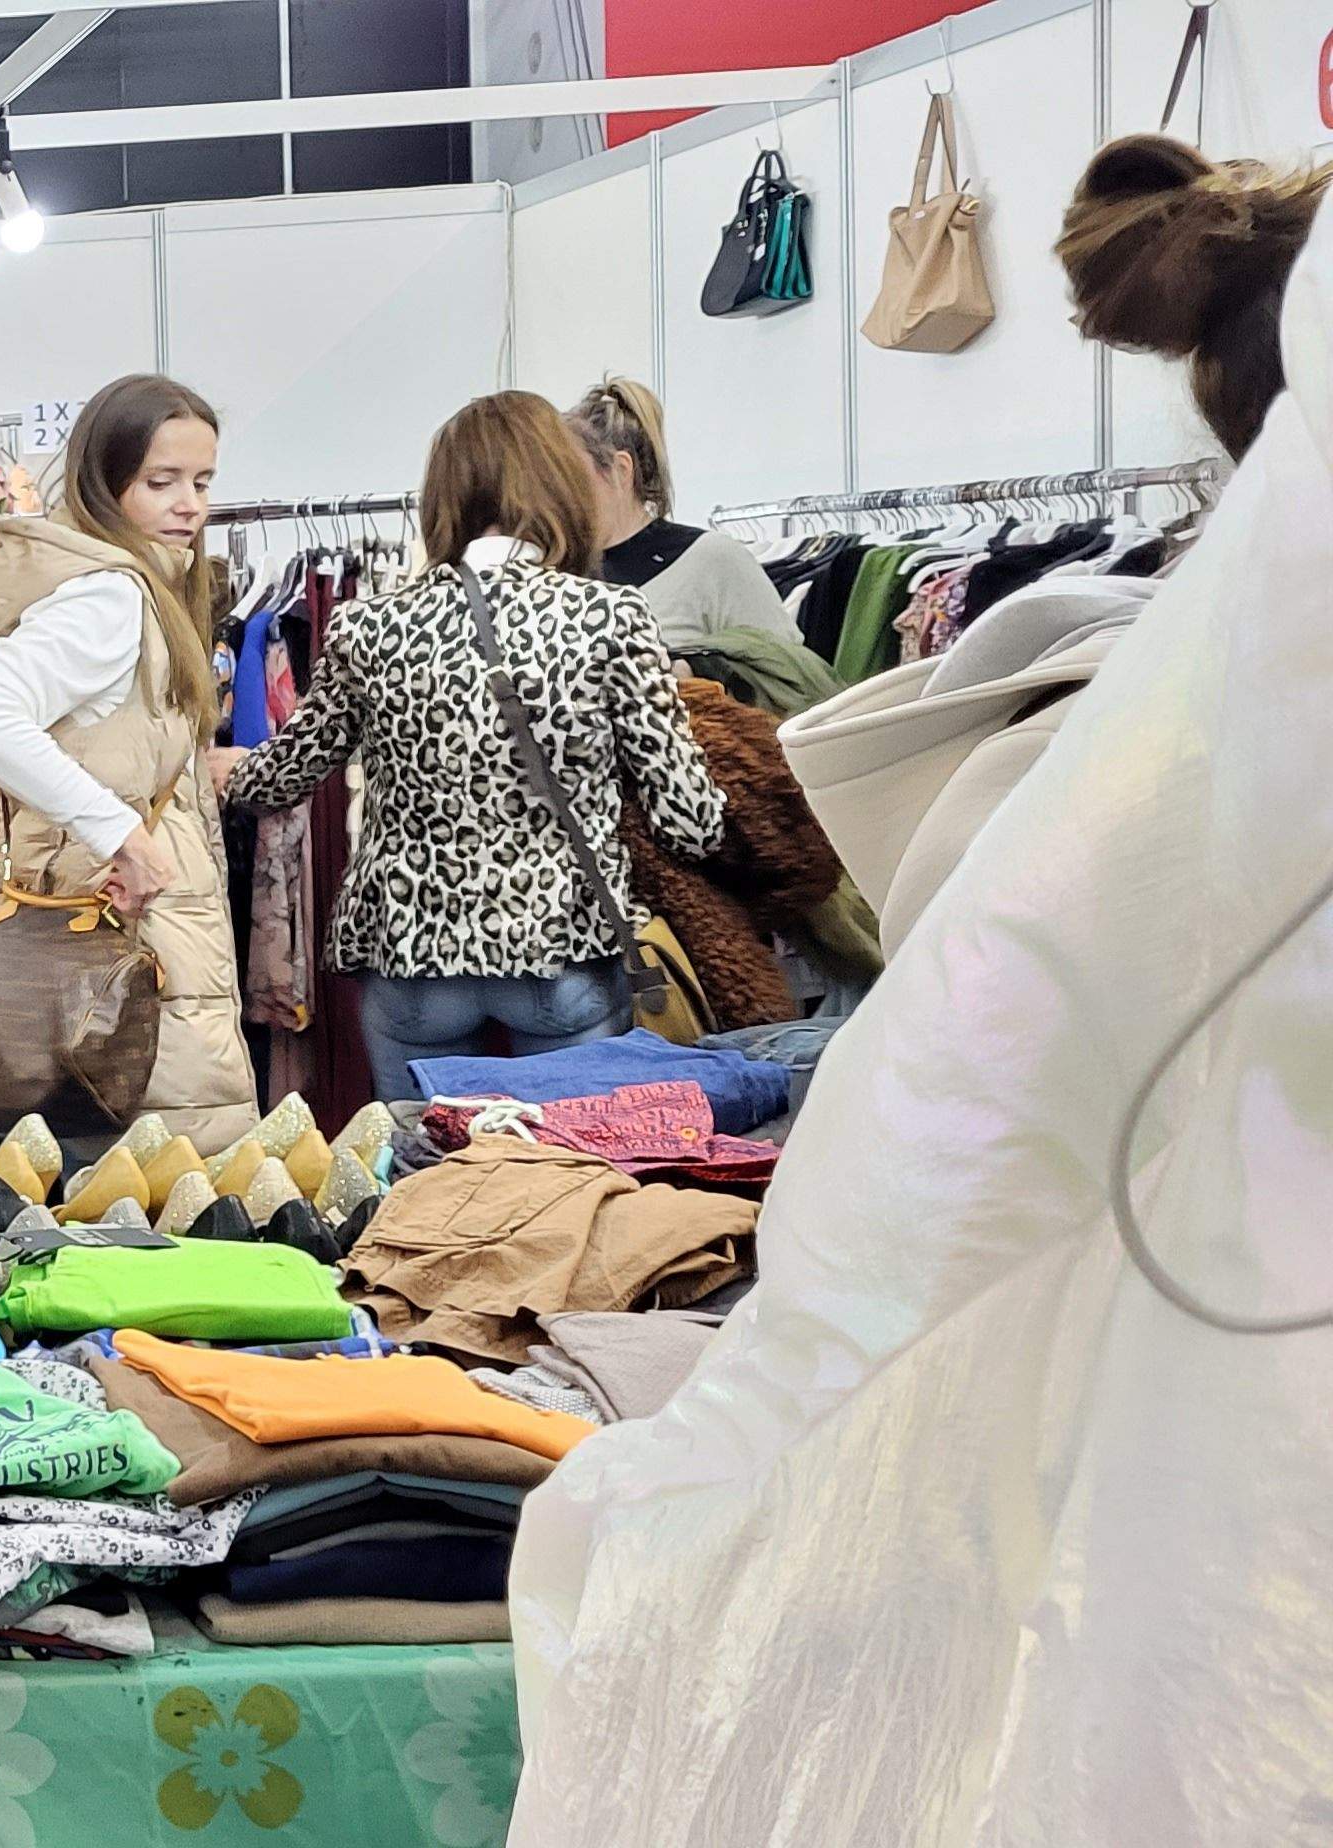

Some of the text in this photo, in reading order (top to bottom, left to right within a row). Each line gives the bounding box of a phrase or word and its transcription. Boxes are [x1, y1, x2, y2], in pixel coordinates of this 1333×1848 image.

[34, 402, 69, 422] 1 X
[34, 428, 48, 446] 2
